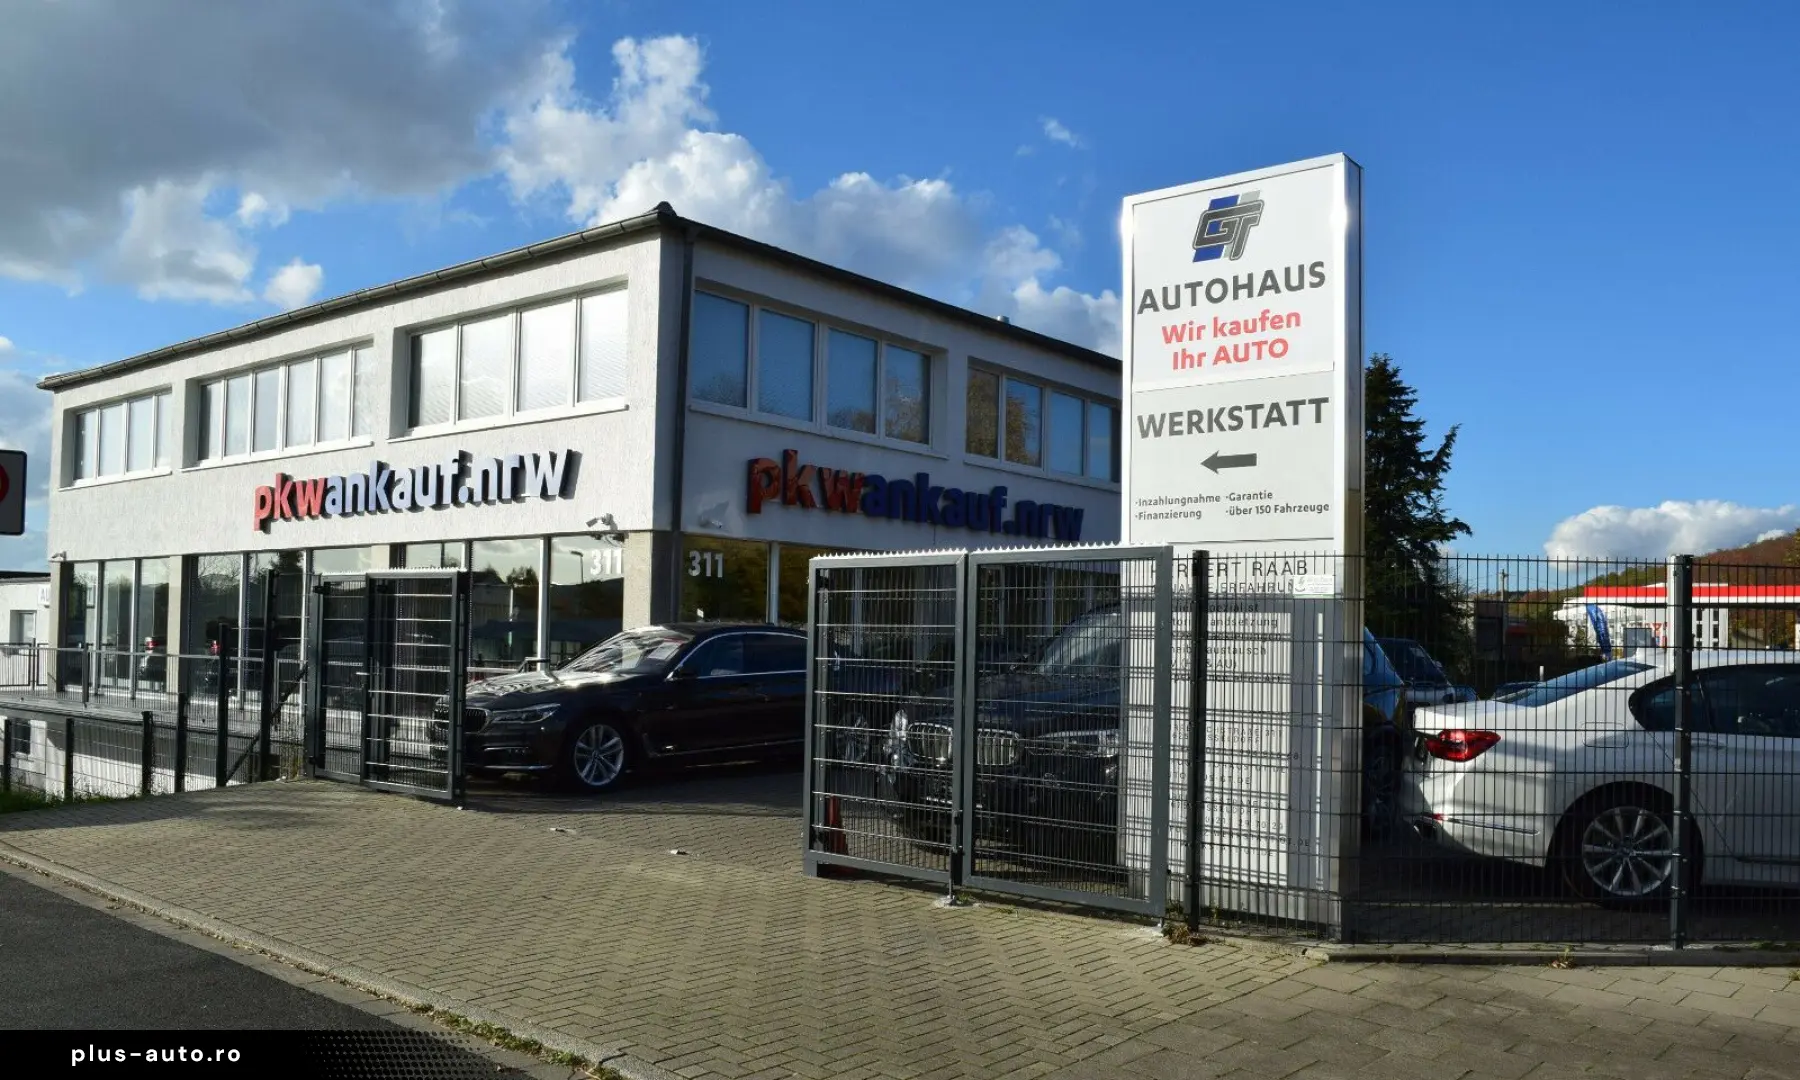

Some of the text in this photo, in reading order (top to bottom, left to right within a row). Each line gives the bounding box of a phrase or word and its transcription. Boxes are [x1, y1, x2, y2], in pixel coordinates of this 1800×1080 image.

[1137, 260, 1326, 315] AUTOHAUS
[1161, 309, 1301, 345] Wir kaufen
[1172, 338, 1289, 371] Ihr AUTO
[1137, 397, 1329, 439] WERKSTATT
[253, 449, 583, 534] pkwankauf.nrw
[746, 448, 1084, 541] pkwankauf.nrw
[1255, 504, 1272, 514] 150
[1274, 502, 1330, 514] Fahrzeuge
[590, 549, 622, 576] 311
[688, 550, 724, 578] 311
[1252, 560, 1308, 577] RAAB
